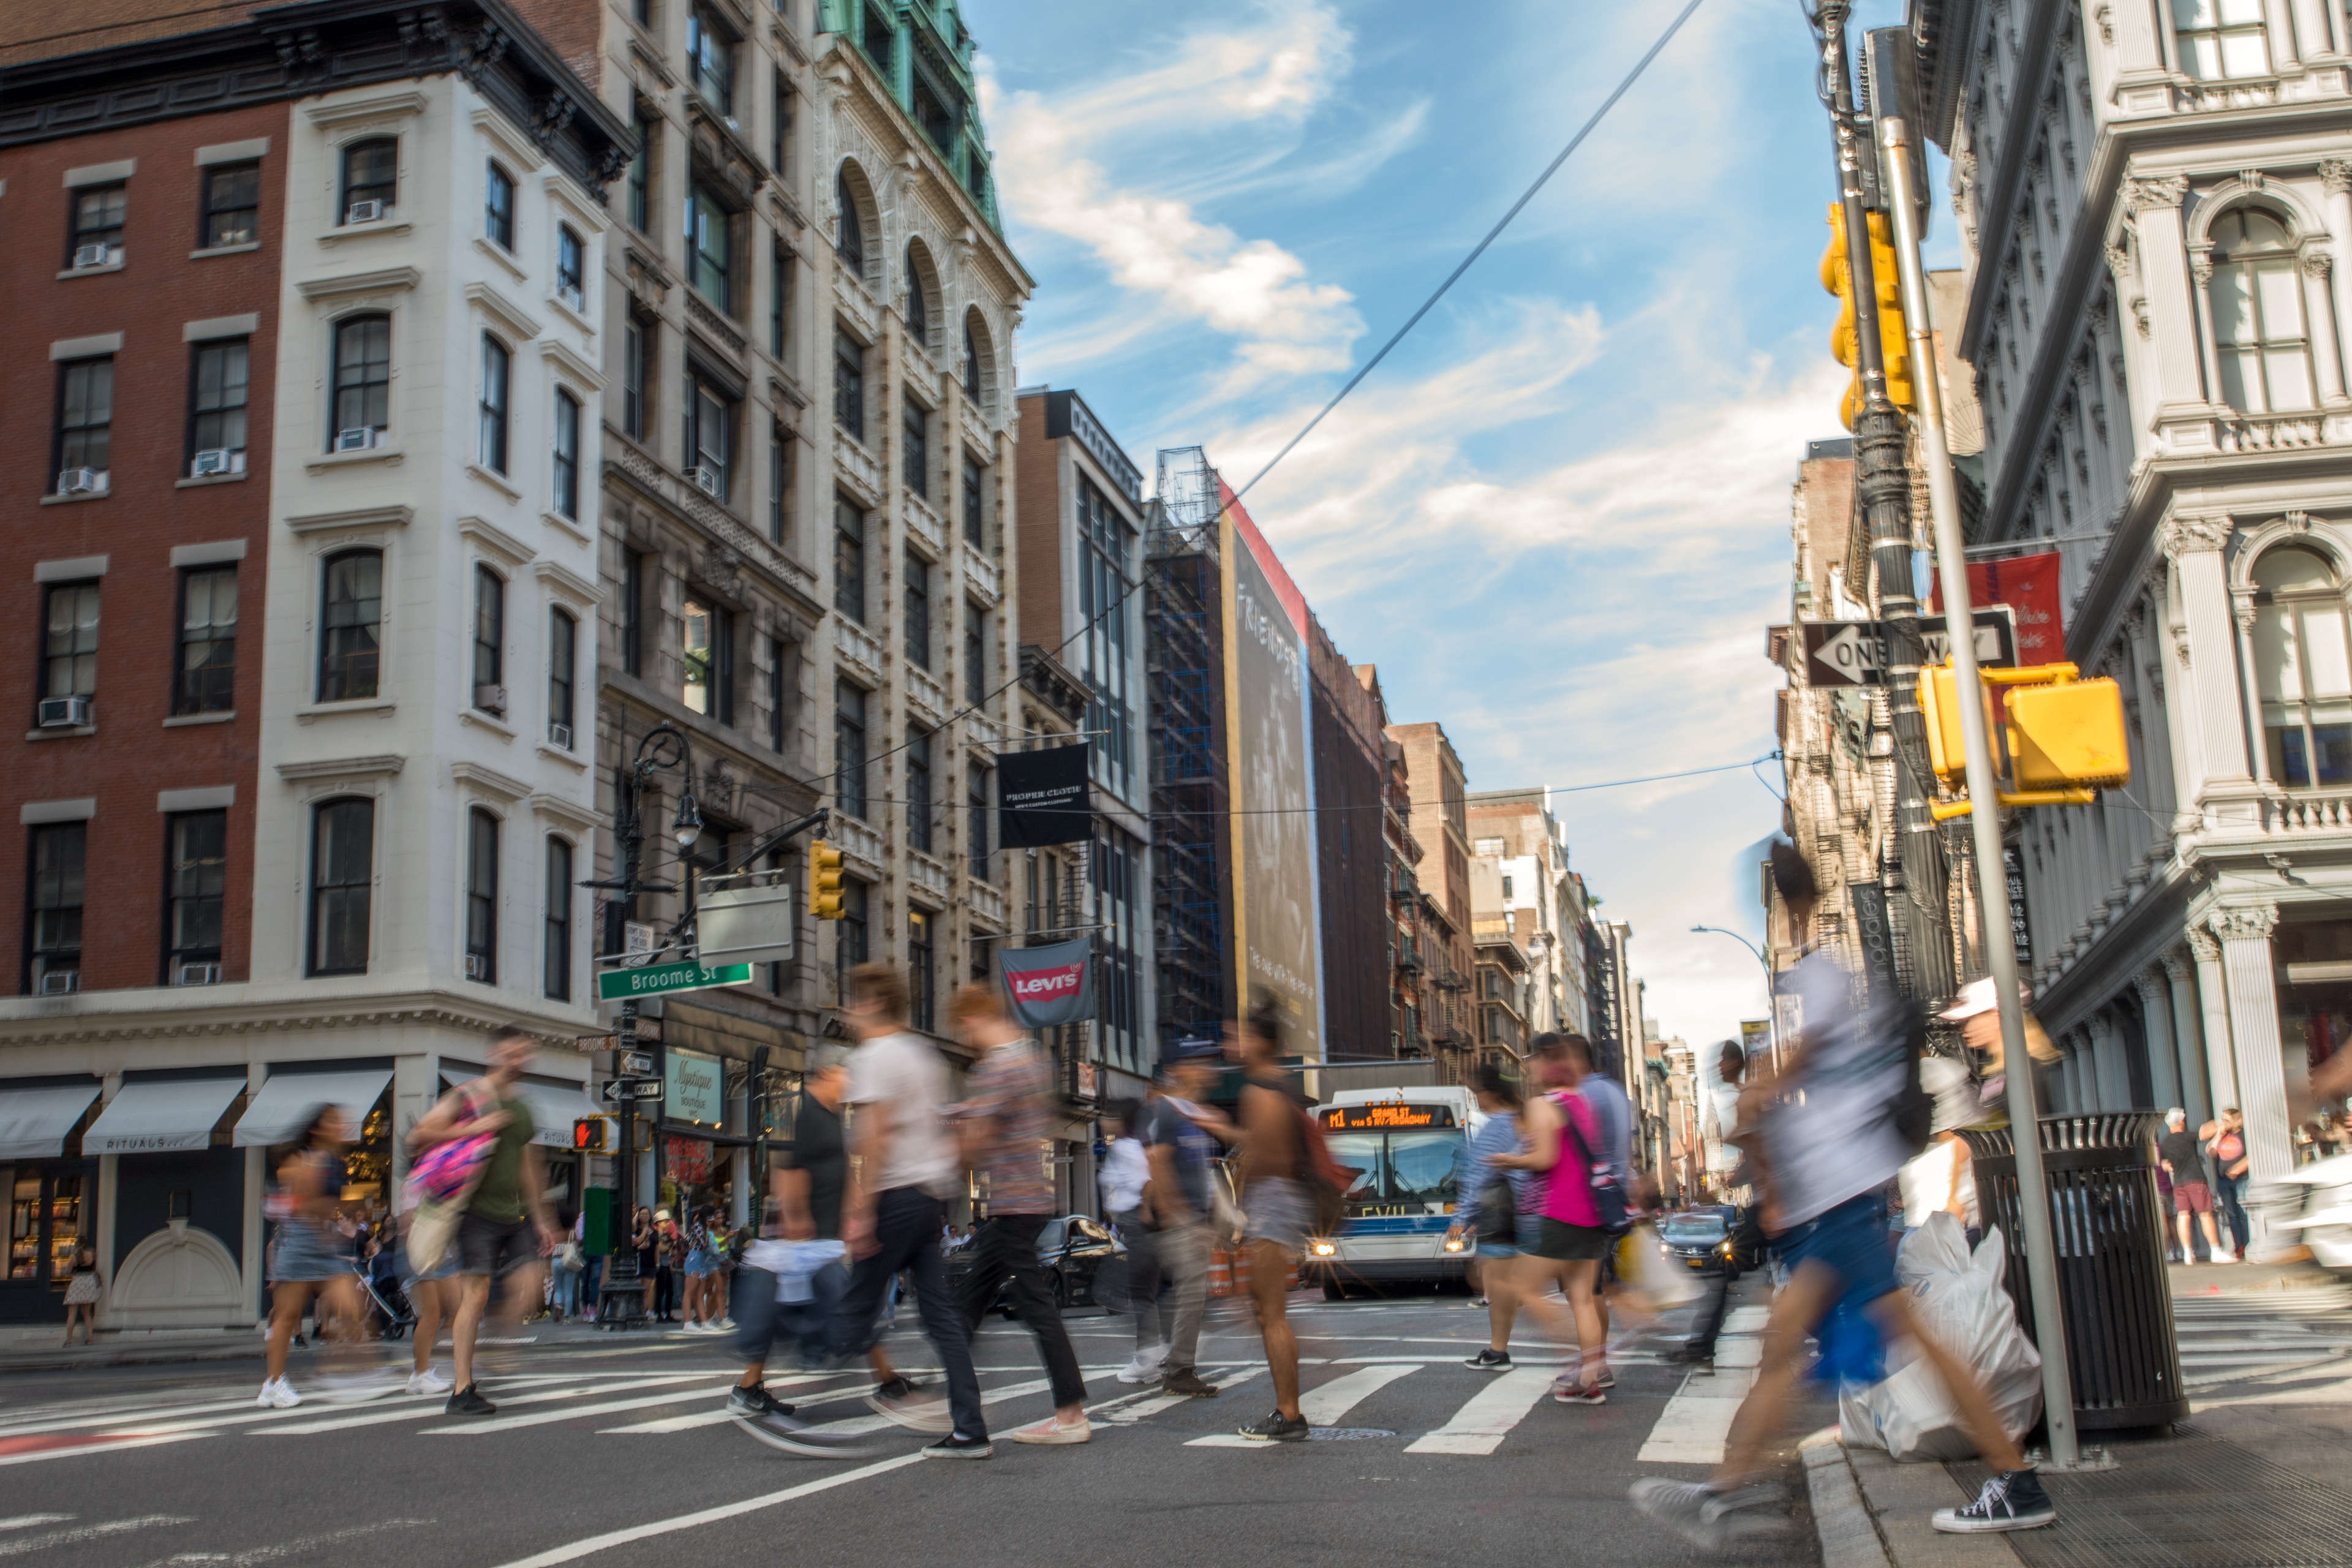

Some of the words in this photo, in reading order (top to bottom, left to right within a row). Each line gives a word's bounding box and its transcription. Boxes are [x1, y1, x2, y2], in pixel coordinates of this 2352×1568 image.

[1834, 641, 1887, 669] ONE
[1923, 635, 1986, 666] WY
[1006, 791, 1046, 802] PROPER
[1047, 785, 1082, 797] CLOTH
[631, 969, 694, 990] Broome
[701, 967, 717, 981] St
[636, 1022, 659, 1039] BROADWAY
[579, 1036, 606, 1052] BROOME
[609, 1035, 618, 1049] ST
[626, 1058, 636, 1068] ONE
[638, 1060, 649, 1070] WAY
[674, 1060, 712, 1099] Mystique
[611, 1087, 620, 1096] ON
[636, 1085, 654, 1095] WAY
[680, 1096, 706, 1110] BOUTIQUE
[689, 1109, 698, 1118] NYC
[1330, 1109, 1346, 1128] M1
[1371, 1107, 1398, 1118] GRAND
[1399, 1106, 1409, 1118] ST
[1374, 1113, 1431, 1126] AV/BROADWAY
